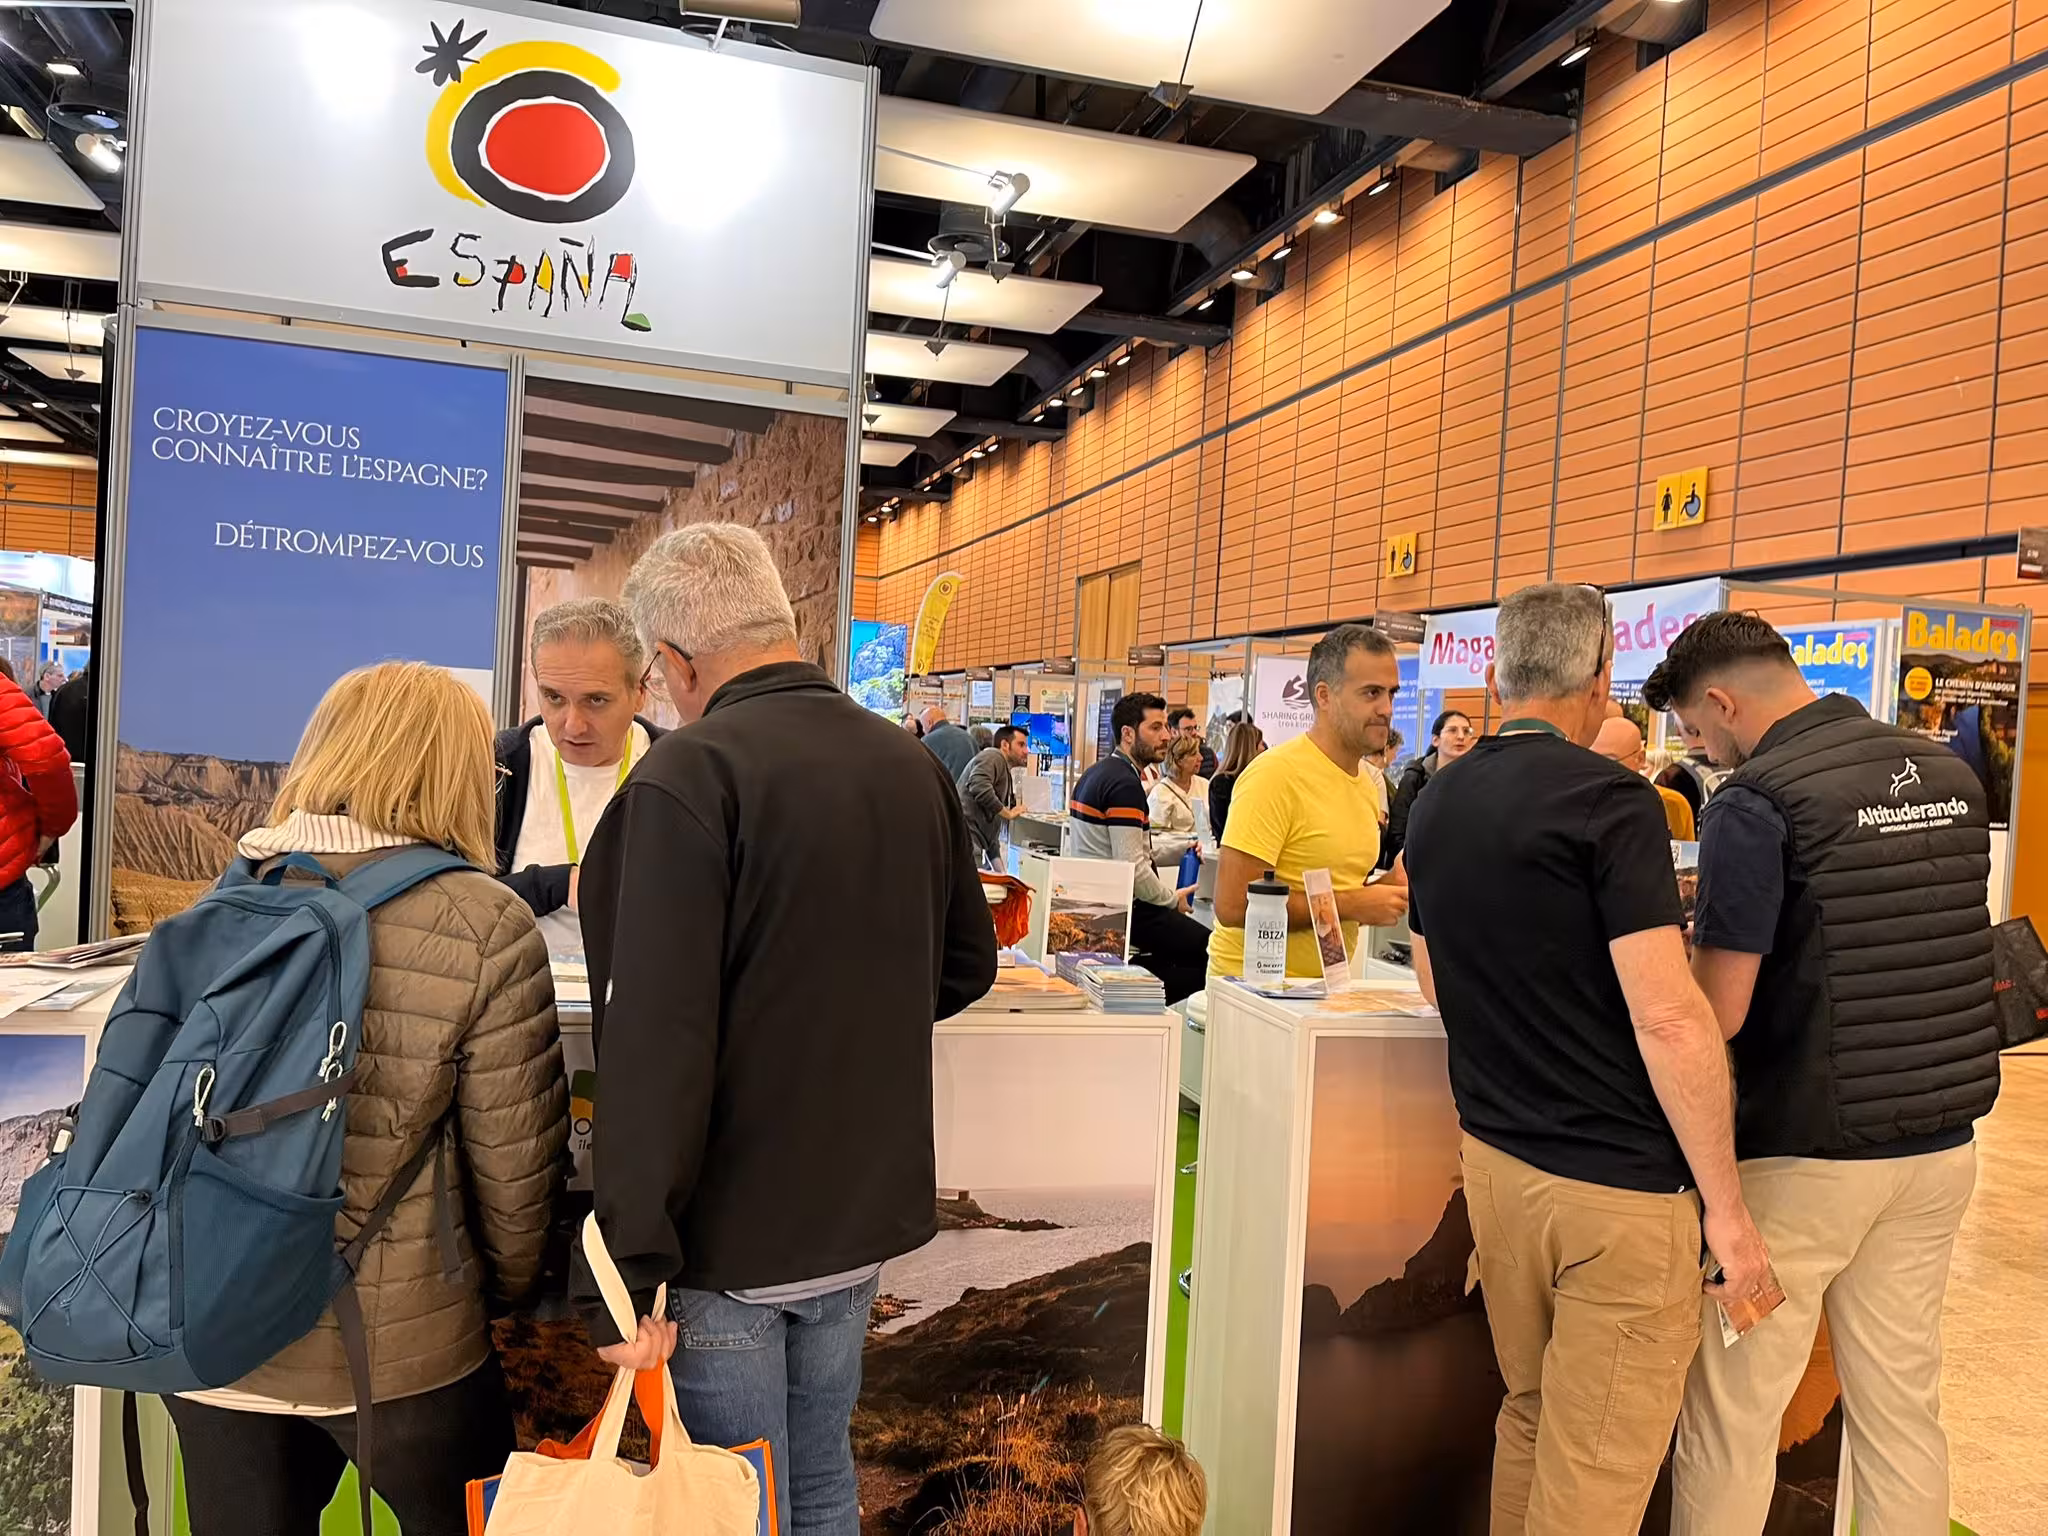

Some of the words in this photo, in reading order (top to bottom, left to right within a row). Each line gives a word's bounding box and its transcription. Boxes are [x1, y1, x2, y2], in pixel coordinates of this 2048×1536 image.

[382, 228, 651, 332] ESPAÑA
[153, 406, 360, 450] CROYEZ-VOUS
[152, 436, 333, 477] CONNAÎTRE
[341, 454, 488, 491] L'ESPAGNE?
[214, 519, 484, 569] DÉTROMPEZ-VOUS
[1907, 610, 2017, 662] Balades
[1262, 711, 1298, 720] SHARING
[1857, 796, 1969, 828] Altituderando
[1257, 930, 1285, 940] IBIZA
